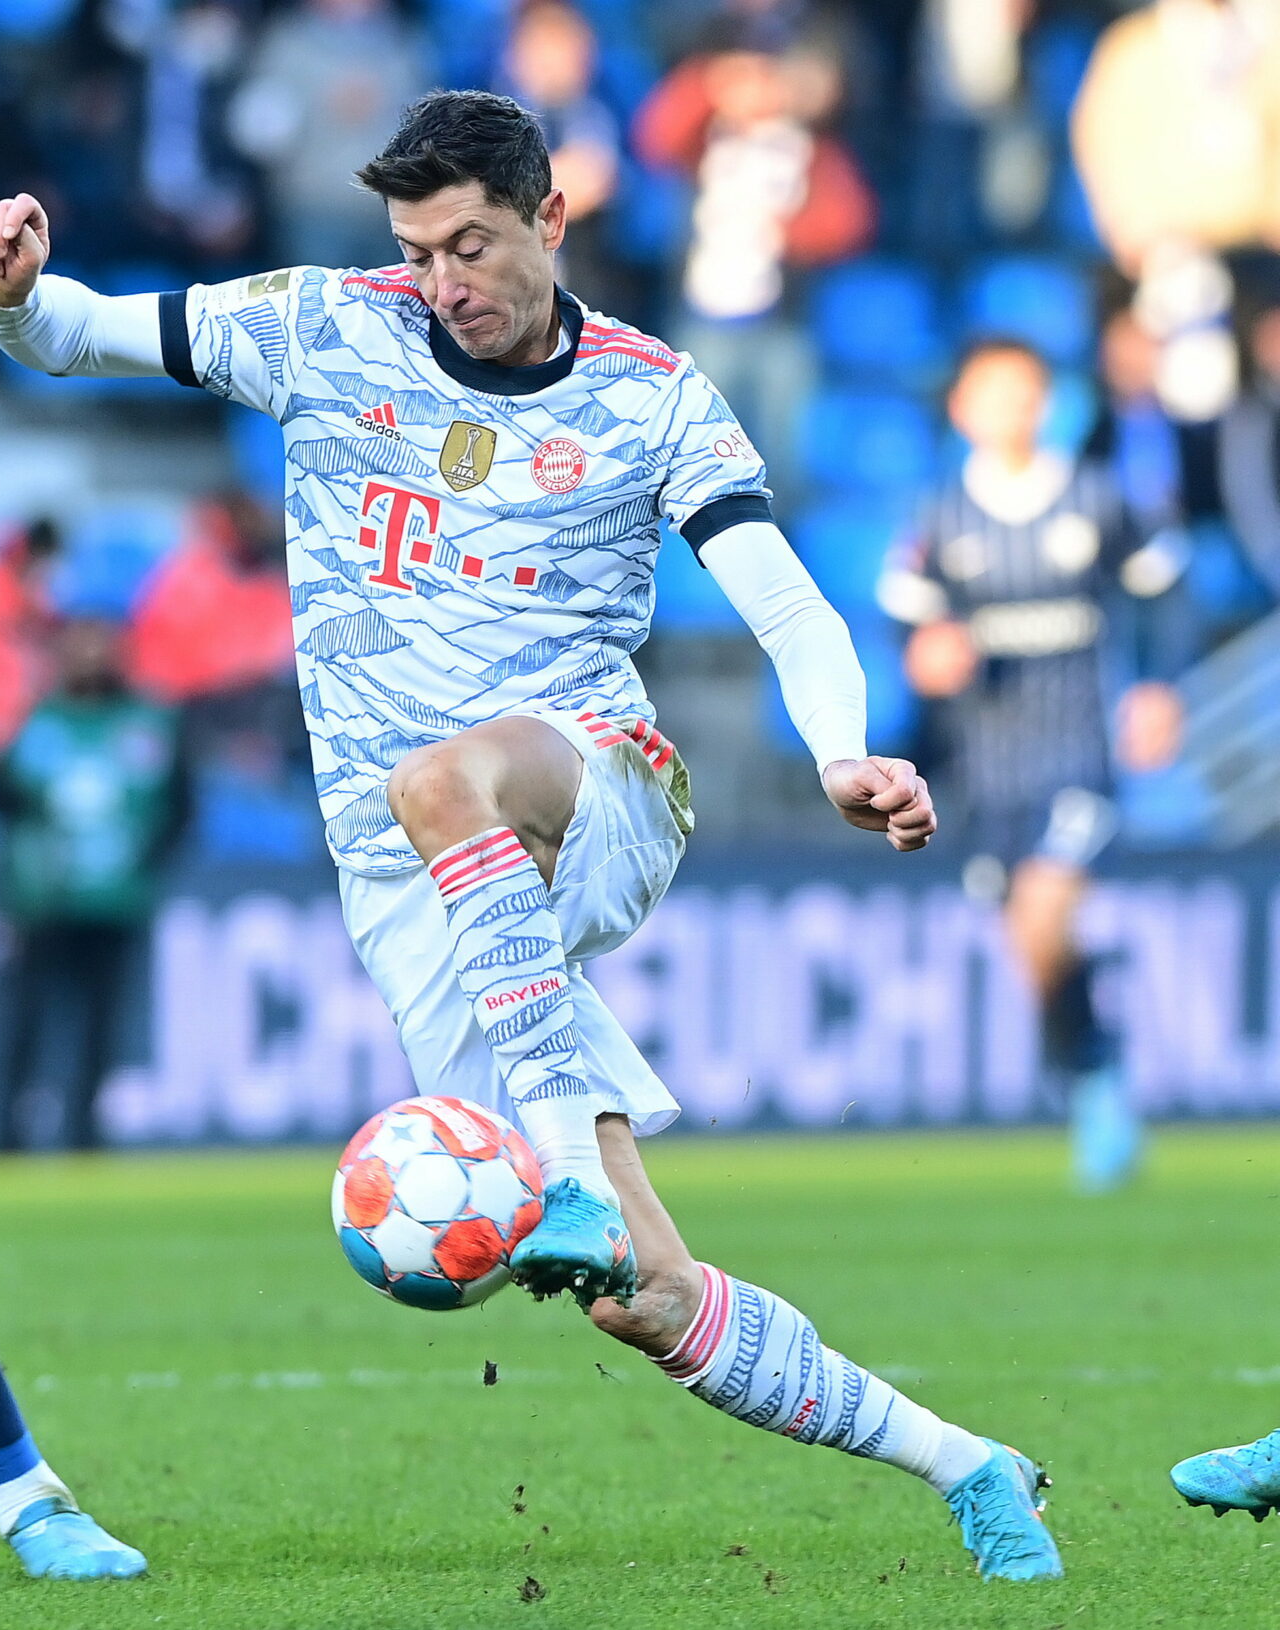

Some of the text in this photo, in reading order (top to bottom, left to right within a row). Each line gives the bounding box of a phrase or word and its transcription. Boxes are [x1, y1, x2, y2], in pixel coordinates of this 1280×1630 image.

[355, 416, 402, 442] adidas
[550, 442, 583, 465] BAYERN
[714, 429, 747, 458] QAT
[451, 464, 475, 480] FIFA
[484, 976, 560, 1011] BAYERN
[782, 1397, 818, 1436] ERN
